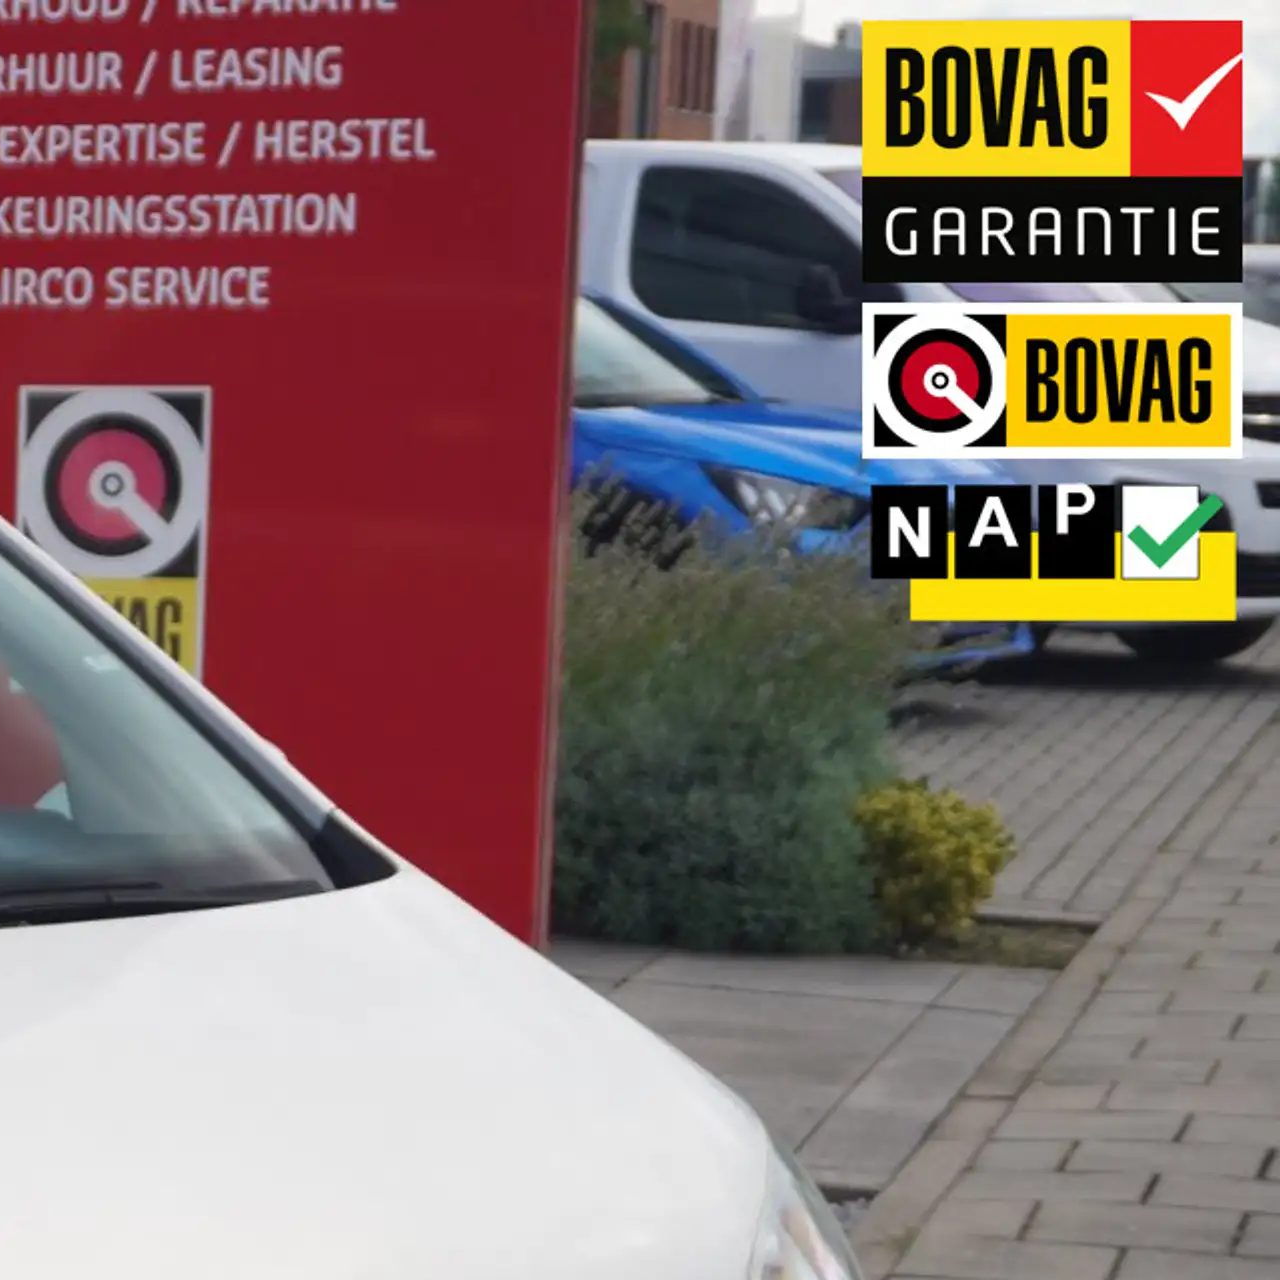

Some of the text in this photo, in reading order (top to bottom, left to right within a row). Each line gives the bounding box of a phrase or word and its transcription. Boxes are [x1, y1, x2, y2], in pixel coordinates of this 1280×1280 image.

[170, 45, 344, 91] LEASING
[254, 117, 436, 163] HERSTEL
[105, 265, 271, 309] SERVICE
